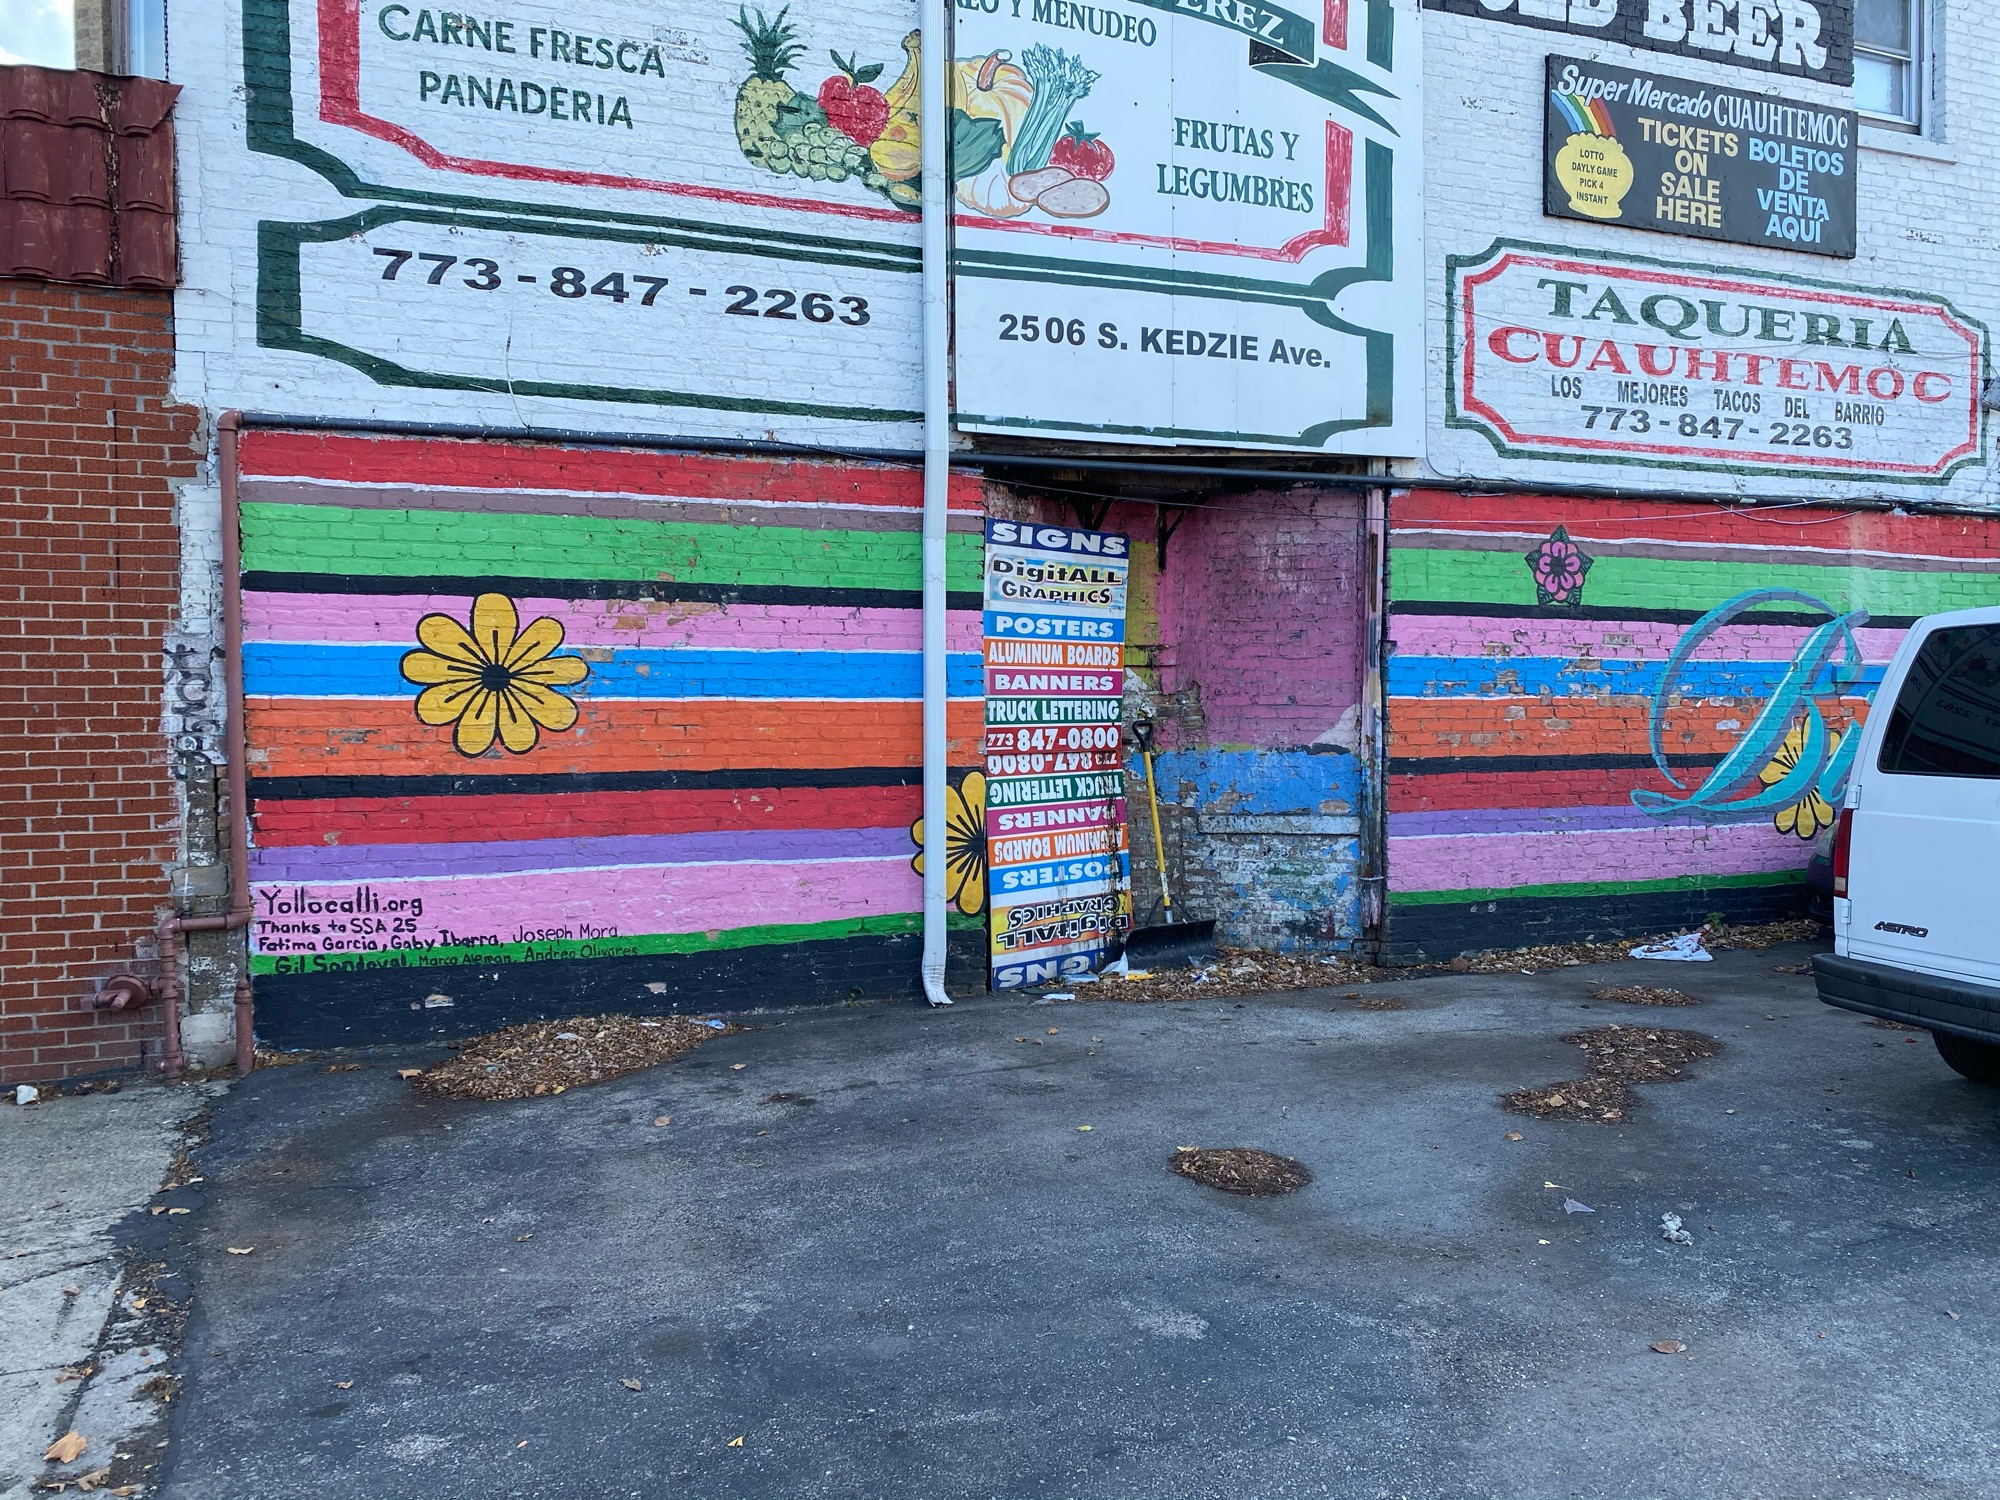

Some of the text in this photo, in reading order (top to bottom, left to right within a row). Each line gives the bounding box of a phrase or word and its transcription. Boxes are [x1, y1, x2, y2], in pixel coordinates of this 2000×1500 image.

[1031, 0, 1157, 47] MENUDEO
[1643, 0, 1829, 70] BEER
[378, 3, 665, 79] CARNE FRESCA
[420, 70, 633, 130] PANADERIA
[1558, 64, 1848, 148] Super Mercado CUAUHTEMOC
[1174, 116, 1299, 162] FRUTAS Y
[1637, 117, 1739, 157] TICKETS
[1571, 161, 1618, 178] DAYLY GAME
[1580, 148, 1604, 161] LOTTO
[1674, 150, 1707, 177] ON
[1749, 137, 1844, 176] BOLETOS
[1157, 163, 1314, 213] LEGUMBRES
[1579, 177, 1604, 190] PICK 4
[1661, 172, 1720, 203] SALE
[1779, 167, 1809, 193] DE
[1576, 191, 1608, 205] INSTANT
[1656, 196, 1722, 228] HERE
[1757, 188, 1829, 221] VENTA
[1537, 278, 1919, 355] TAQUERIA
[998, 313, 1331, 368] 2506 S. KEDZIE Ave.
[1487, 326, 1952, 403] CUAUHTEMOC
[1551, 374, 1885, 427] LOS MEJORES TACOS DEL BARRIO
[991, 521, 1126, 555] SIGNS
[992, 559, 1122, 584] DigitALL
[1001, 580, 1112, 604] GRAPHICS
[996, 615, 1114, 637] POSTERS
[988, 641, 1119, 667] ALUMINUM BOARDS
[995, 674, 1114, 691] BANNERS
[987, 700, 1119, 721] TRUCK LETTERING
[986, 727, 1119, 752] 773 847-0800
[989, 775, 1122, 804] TRUCK LETTERING
[993, 828, 1123, 864] AUMINUM BOARDS
[260, 885, 423, 917] Yollocalli.org
[1008, 895, 1119, 930] GRAPHICS
[256, 917, 417, 935] Thanks to SSA 25
[258, 936, 317, 951] Fatima
[391, 934, 436, 952] Gaby
[512, 924, 573, 946] Joseph
[1874, 921, 1929, 938] ASTRO
[275, 955, 305, 974] Gil
[997, 955, 1098, 988] GNS
